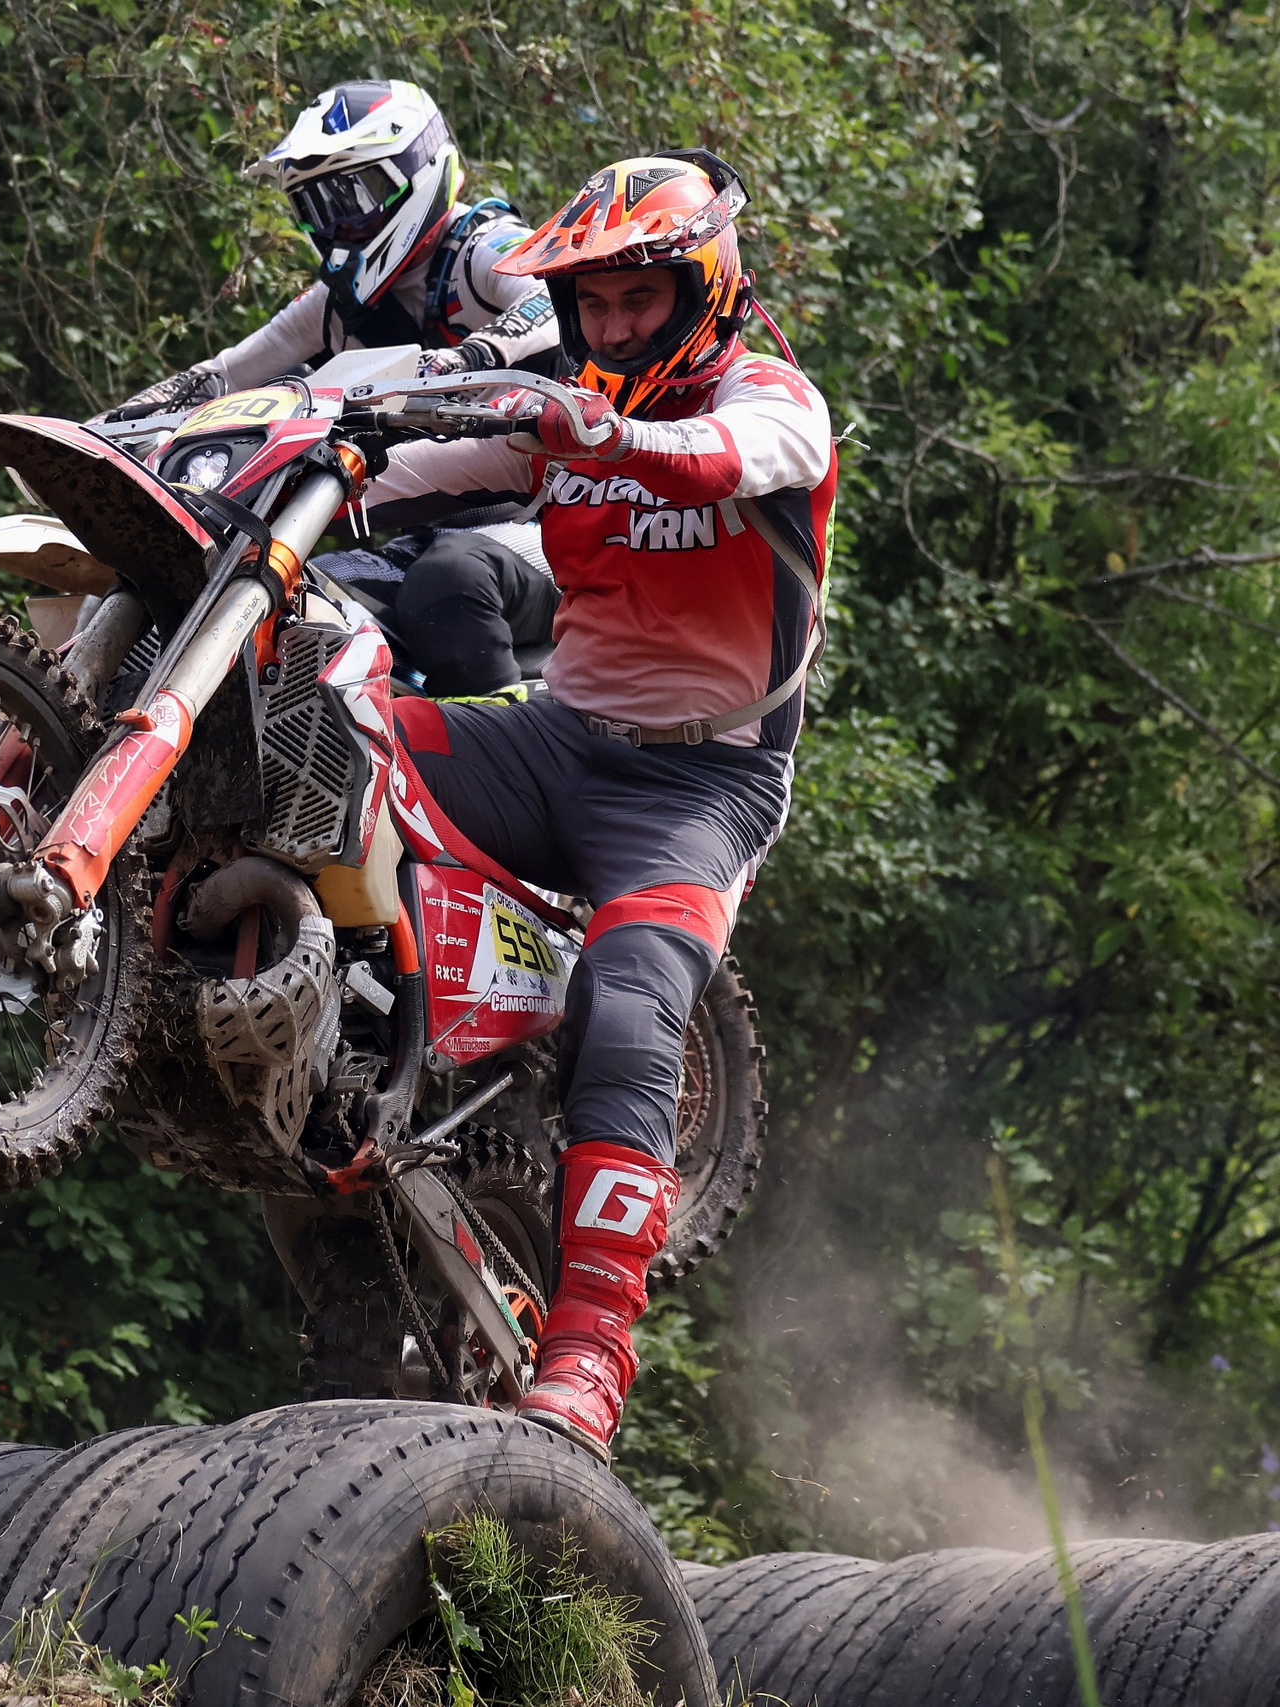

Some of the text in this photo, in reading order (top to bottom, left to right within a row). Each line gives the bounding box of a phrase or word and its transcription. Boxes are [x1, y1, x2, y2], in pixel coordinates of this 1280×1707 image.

[501, 310, 532, 337] MX
[519, 296, 552, 320] BIKE
[187, 397, 280, 429] 550
[495, 912, 561, 979] 550
[574, 1168, 658, 1237] G
